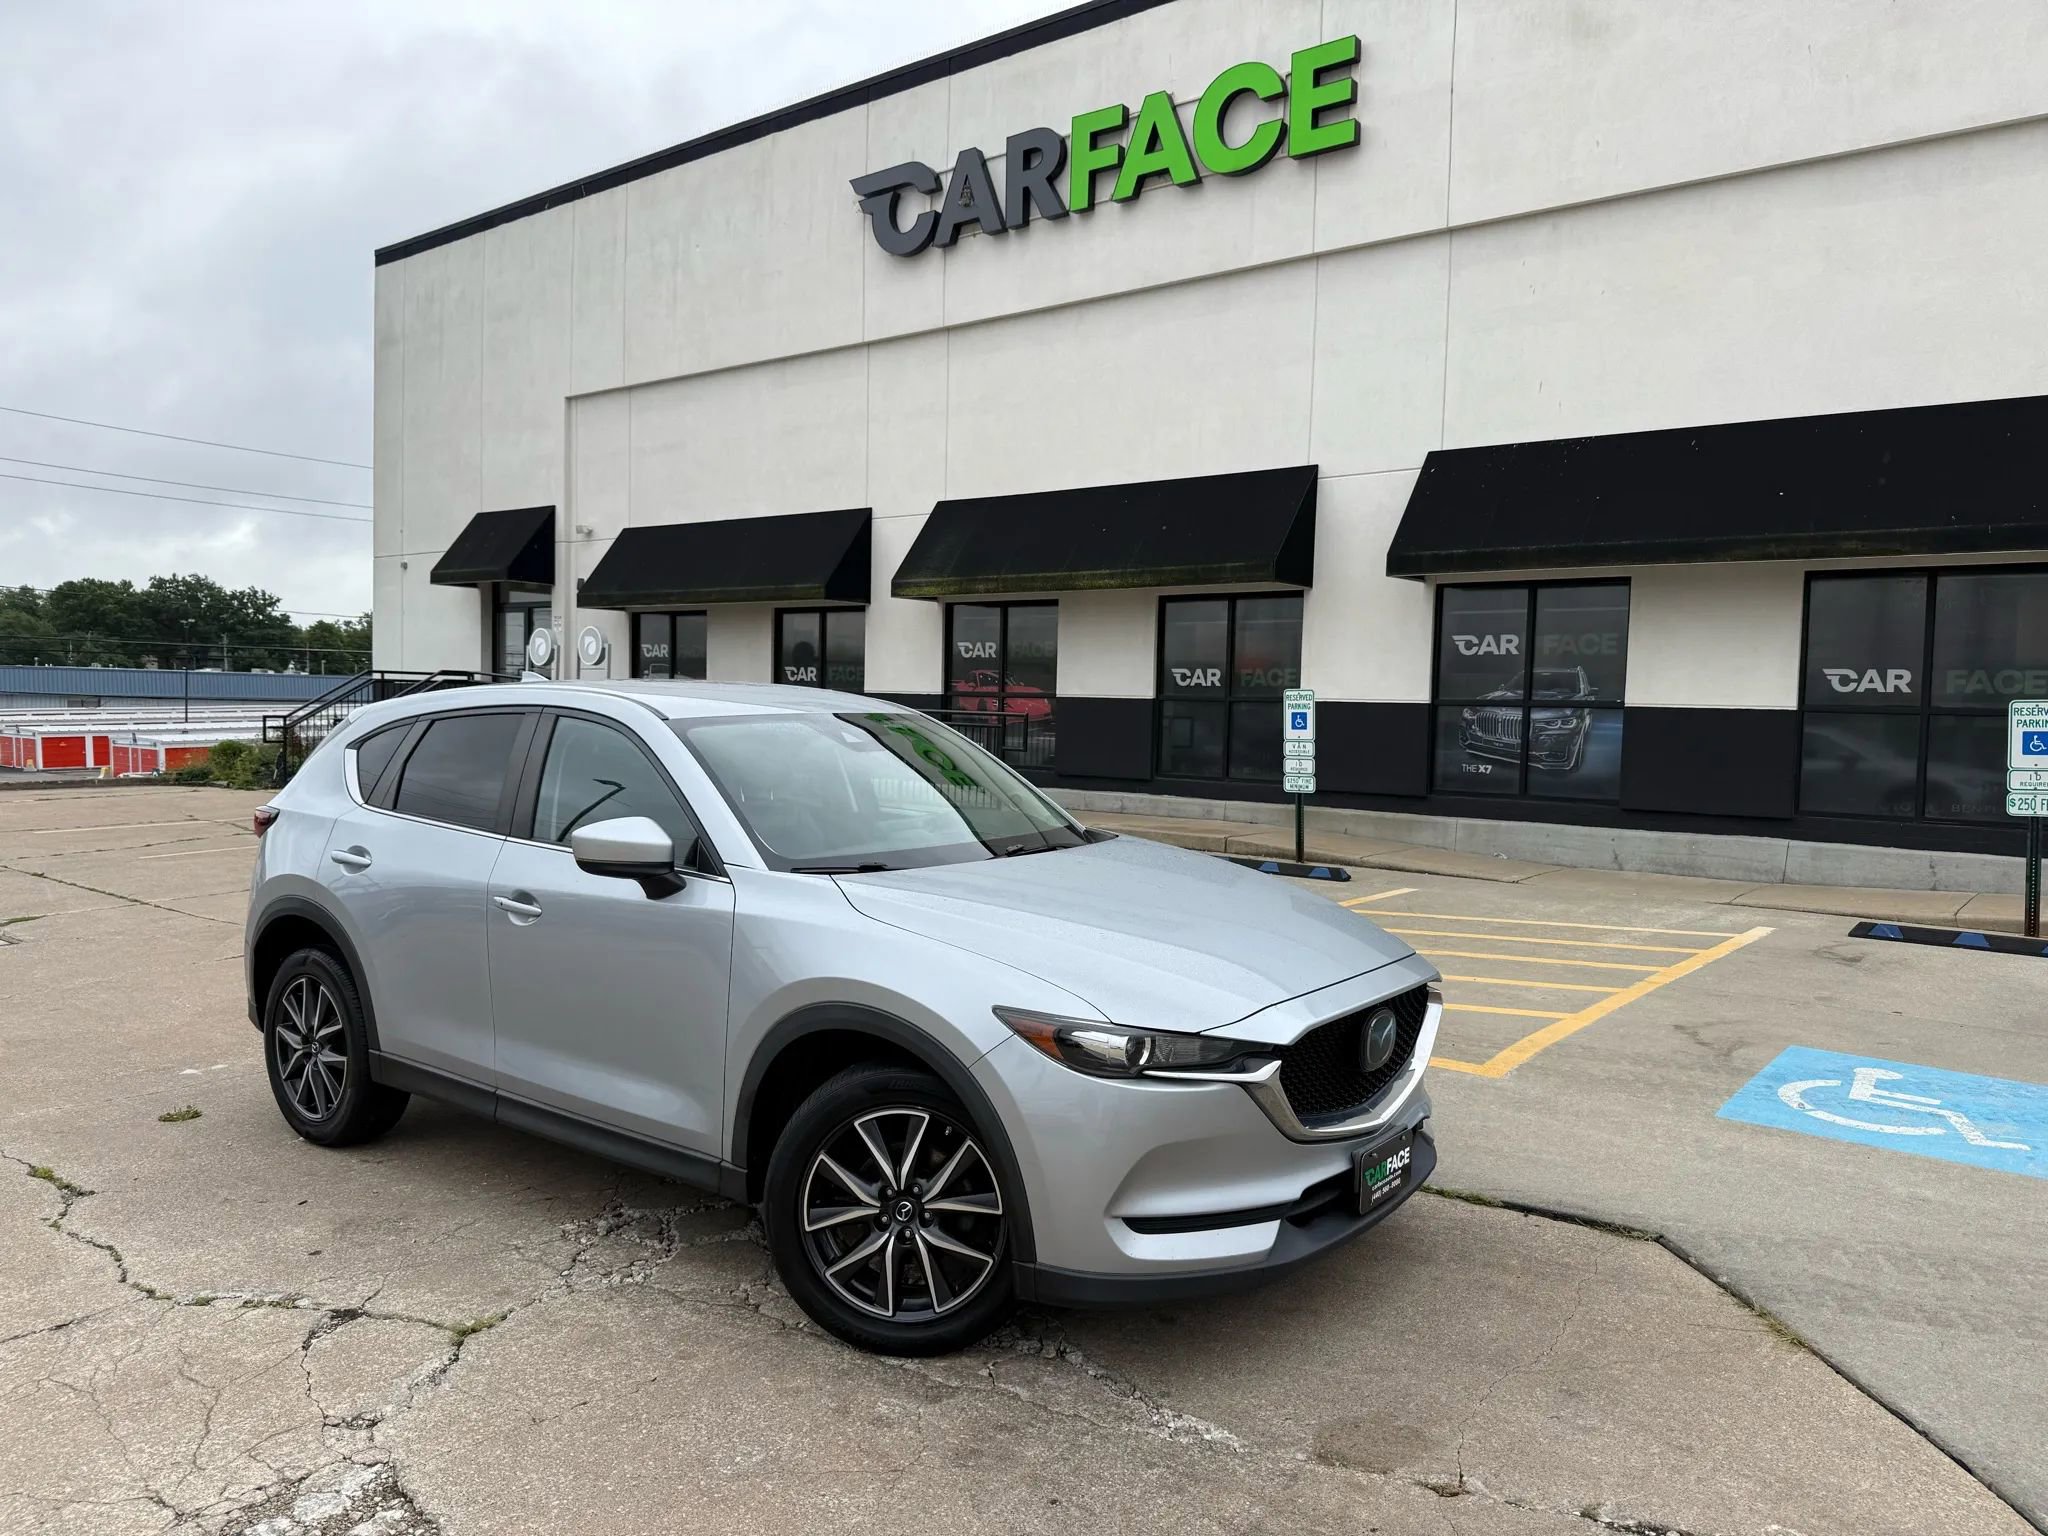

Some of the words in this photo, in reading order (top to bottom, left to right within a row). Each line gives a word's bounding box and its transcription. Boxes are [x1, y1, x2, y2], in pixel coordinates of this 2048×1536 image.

[849, 34, 1361, 257] CARFACE
[641, 644, 669, 658] CAR
[957, 641, 996, 659] CAR
[1452, 634, 1520, 655] CAR
[1543, 633, 1619, 655] FACE
[784, 666, 817, 682] CAR
[1171, 668, 1221, 687] CAR
[1240, 668, 1297, 687] FACE
[1822, 668, 1913, 693] CAR
[1946, 669, 2048, 694] FACE
[1462, 764, 1477, 773] THE
[1478, 765, 1492, 774] X7
[1364, 1146, 1411, 1186] CARFACE
